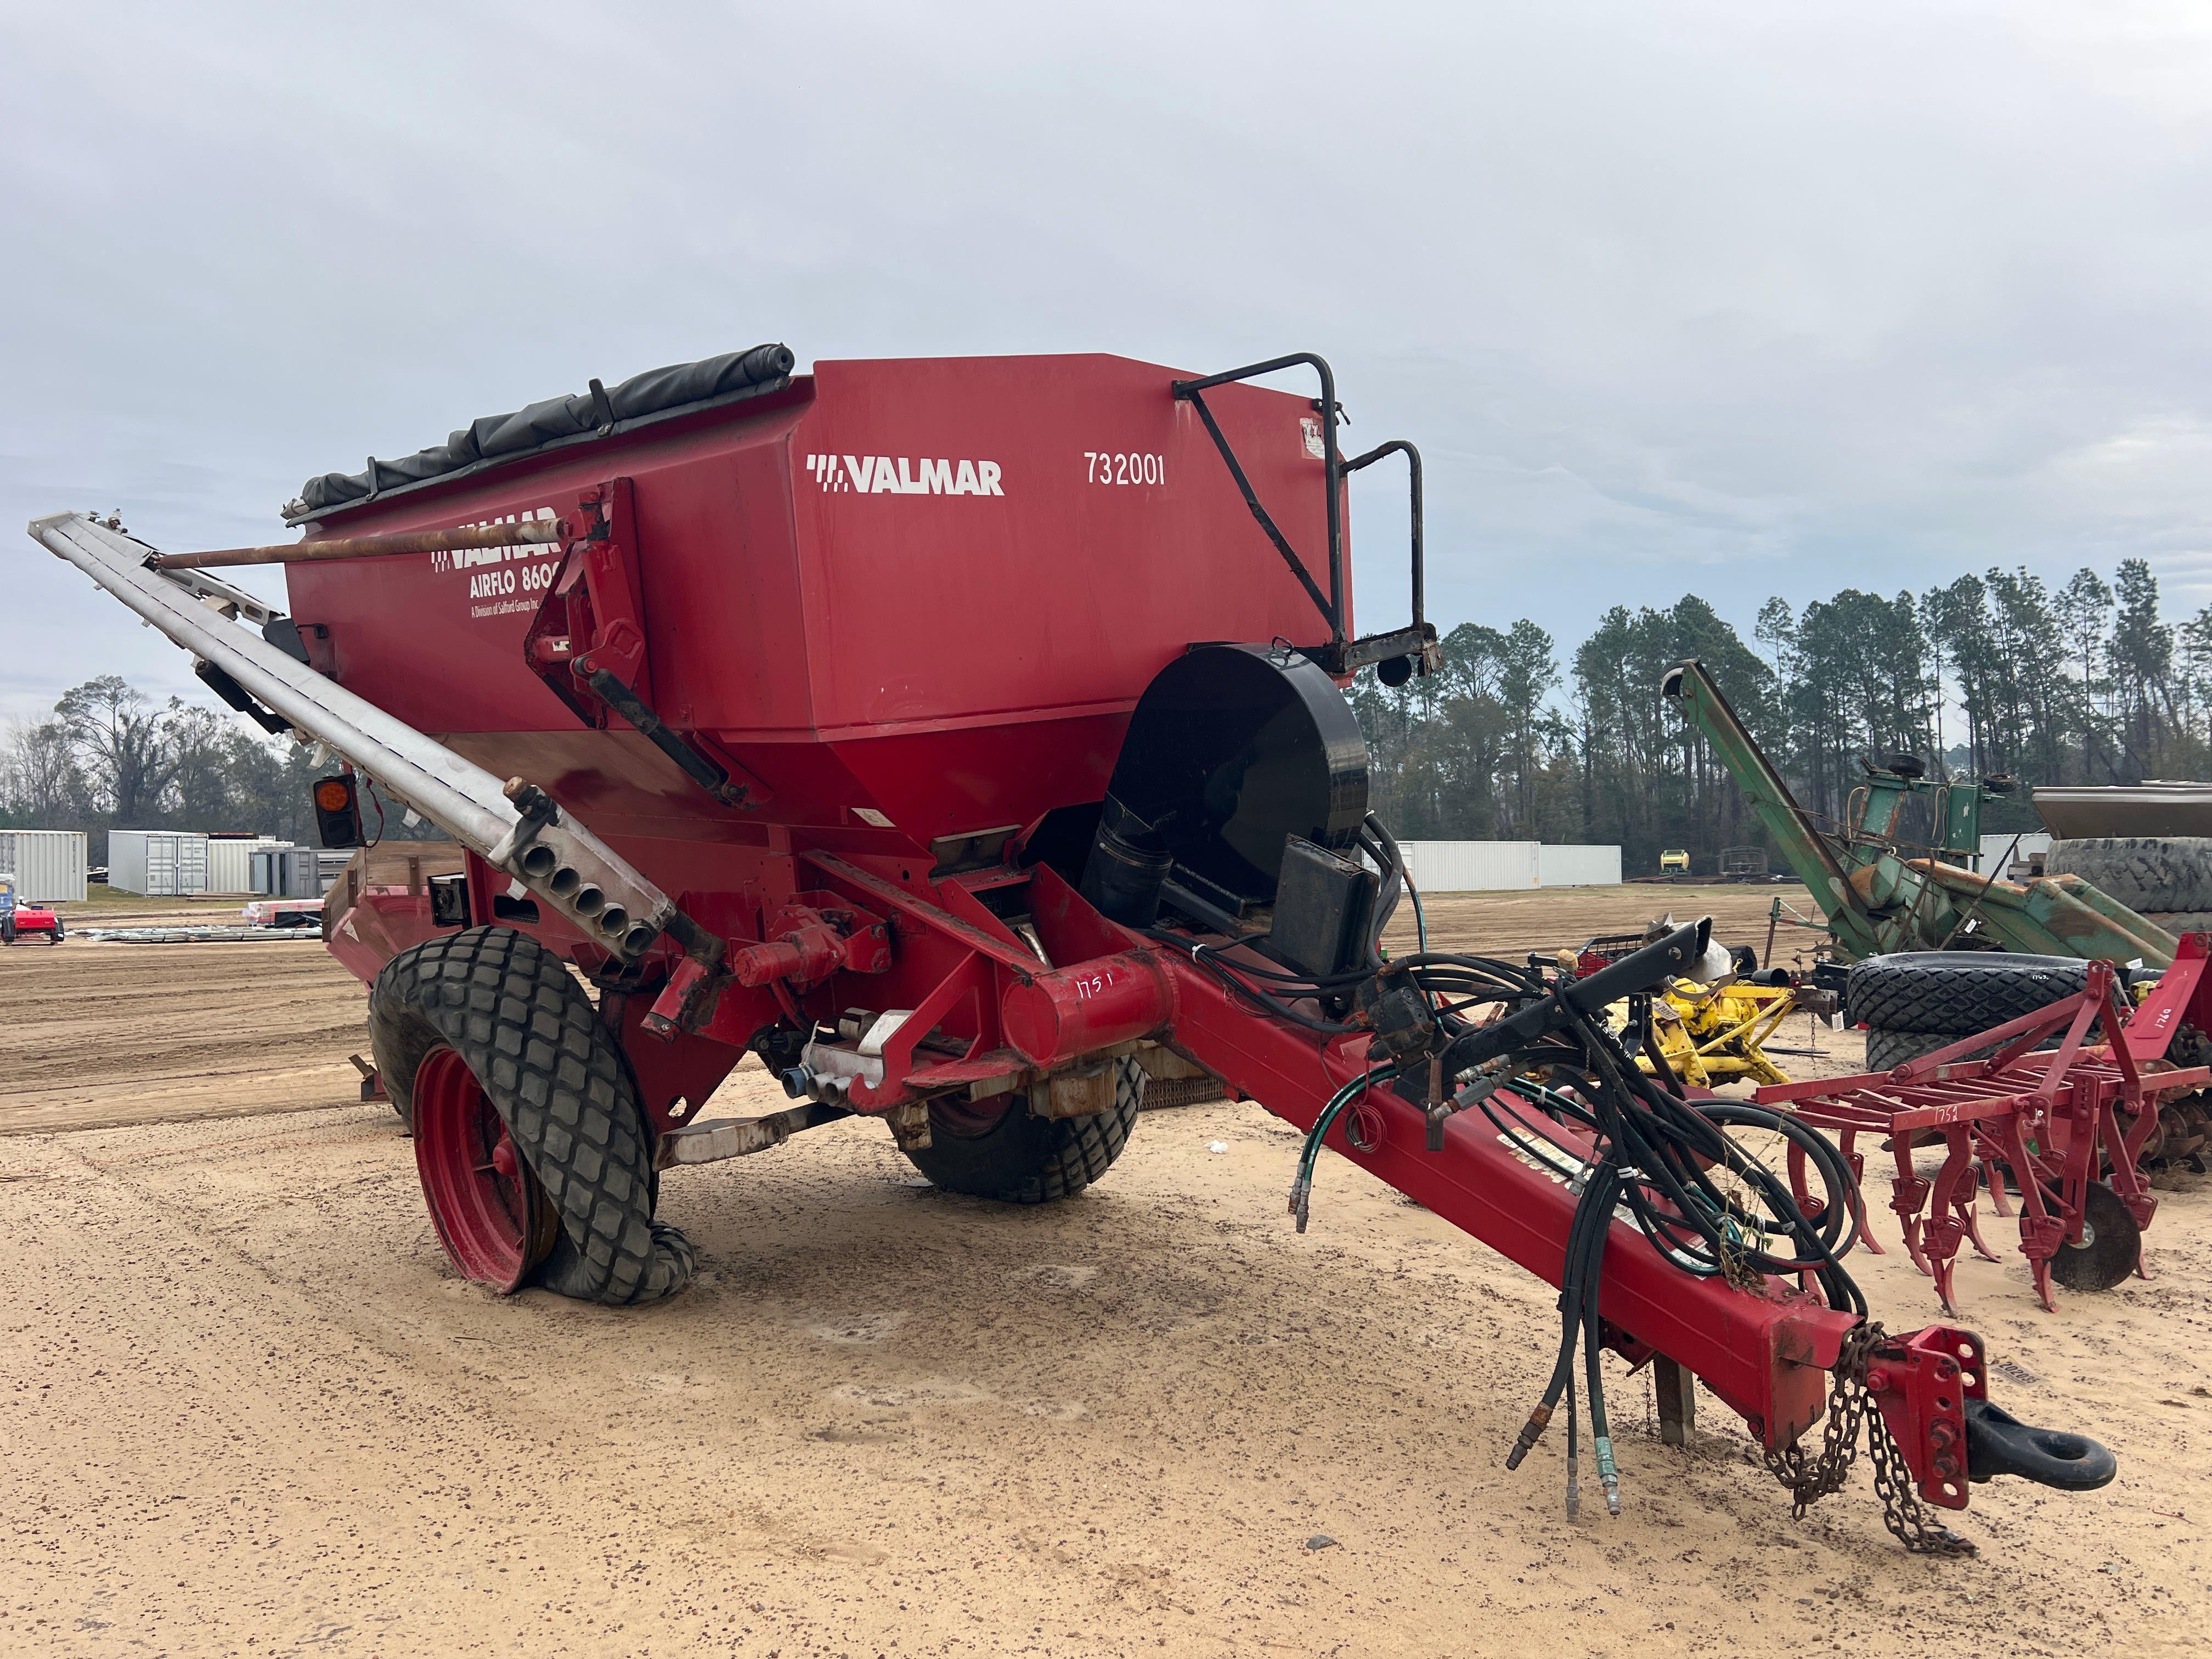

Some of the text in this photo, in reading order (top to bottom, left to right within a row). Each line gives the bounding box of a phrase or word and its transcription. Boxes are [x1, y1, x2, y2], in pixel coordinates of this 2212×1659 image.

[843, 455, 1005, 496] VALMAR
[1084, 452, 1165, 485] 732001
[470, 569, 515, 599] AIRFLO
[471, 606, 476, 618] A
[475, 605, 493, 618] Division
[493, 602, 499, 615] of
[498, 600, 515, 614] Salford
[515, 599, 531, 612] Group
[1076, 973, 1113, 998] 1751
